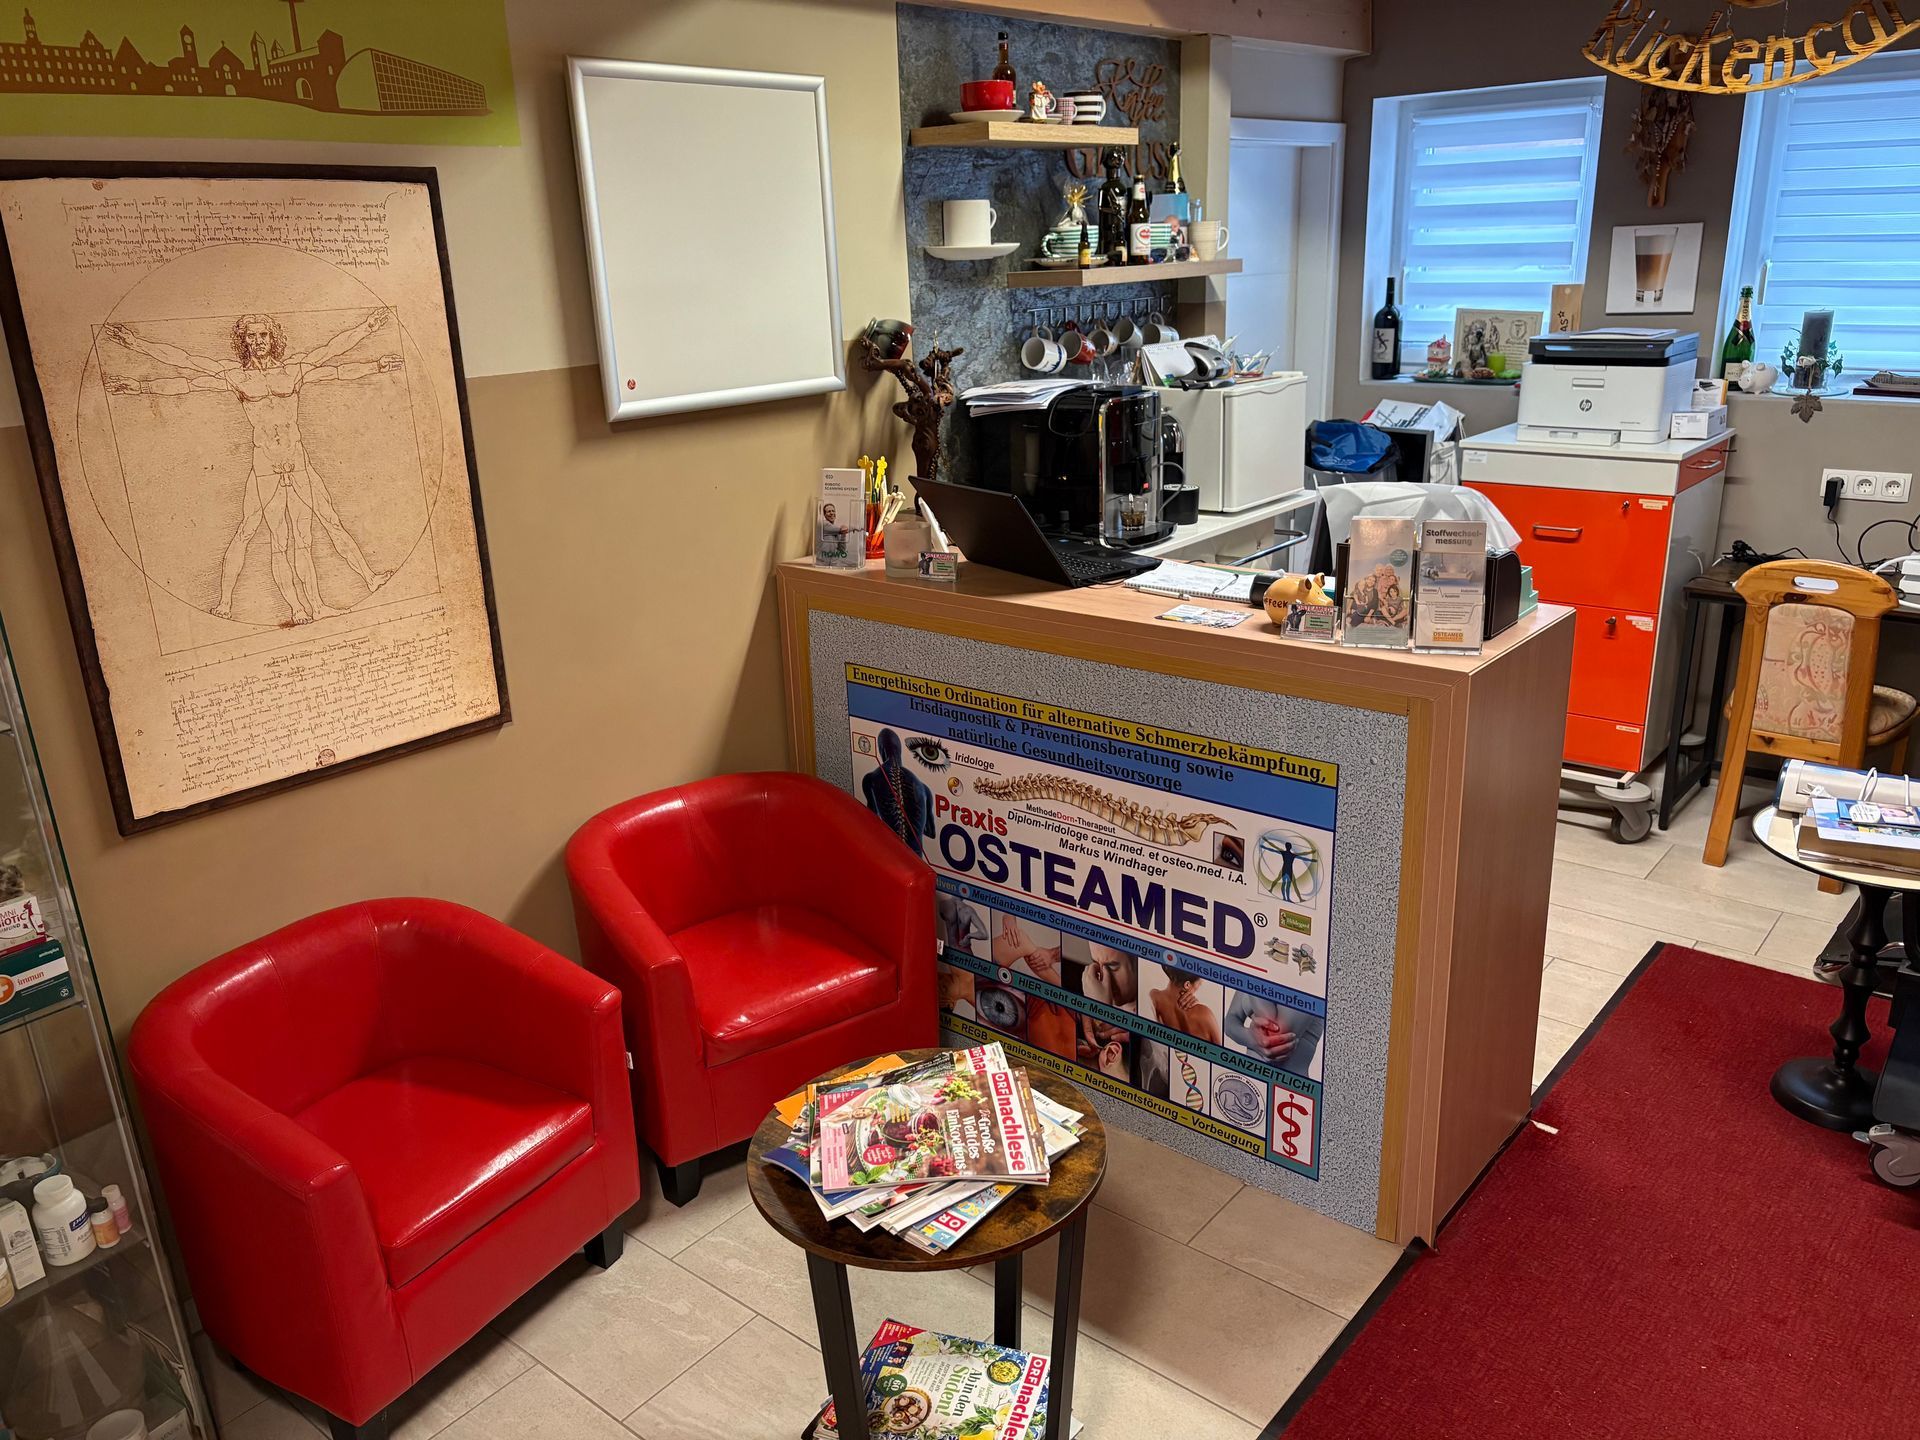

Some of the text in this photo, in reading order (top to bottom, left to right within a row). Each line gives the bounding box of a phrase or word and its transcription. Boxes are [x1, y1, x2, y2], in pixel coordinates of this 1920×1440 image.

[1579, 399, 1592, 412] hp
[1426, 529, 1483, 537] Stoffwechsel-
[1435, 538, 1472, 546] messung
[853, 667, 1327, 783] Energethische Ordination für alternative Schmerzbekämpfung,
[909, 698, 1234, 782] Irisdiagnostik & Präventionsberatung sowie
[948, 726, 1182, 793] natürliche Gesundheitsvorsorge
[954, 752, 995, 771] Iridologe
[935, 793, 1008, 837] Praxis
[1025, 803, 1116, 834] MethodeDorn-Therapeut
[1007, 810, 1089, 842] Diplom-Iridologe
[1091, 832, 1146, 857] cand.med.
[1148, 848, 1160, 861] et
[1162, 853, 1225, 879] osteo.med.
[1059, 837, 1168, 878] Markus Windhager
[972, 888, 1046, 920] Meridianbasierte
[1049, 912, 1161, 959] Schmerzanwendungen
[1179, 956, 1244, 987] Volksleiden
[1246, 979, 1317, 1012] bekämpfen!
[17, 971, 45, 986] immun
[1018, 976, 1042, 993] HIER
[1044, 986, 1069, 1004] steht
[1070, 994, 1087, 1010] der
[1089, 1000, 1129, 1025] Mensch
[1131, 1017, 1144, 1031] im
[1146, 1023, 1208, 1055] Mittelpunkt
[1220, 1051, 1316, 1095] GANZHEITLICH!
[961, 1023, 988, 1040] REGB
[1000, 1041, 1061, 1071] craniosacrale
[1062, 1061, 1074, 1076] IR
[1084, 1072, 1178, 1121] Narbenentstörung
[1191, 1115, 1262, 1153] Vorbeugung
[945, 1109, 967, 1170] Einkochens
[962, 1115, 980, 1159] Welt des
[978, 1118, 996, 1154] Große
[995, 1074, 1026, 1171] ORF nachlese
[938, 1213, 961, 1228] OR
[935, 1364, 969, 1417] Süden!
[1028, 1360, 1043, 1387] ORF
[952, 1395, 971, 1417] den
